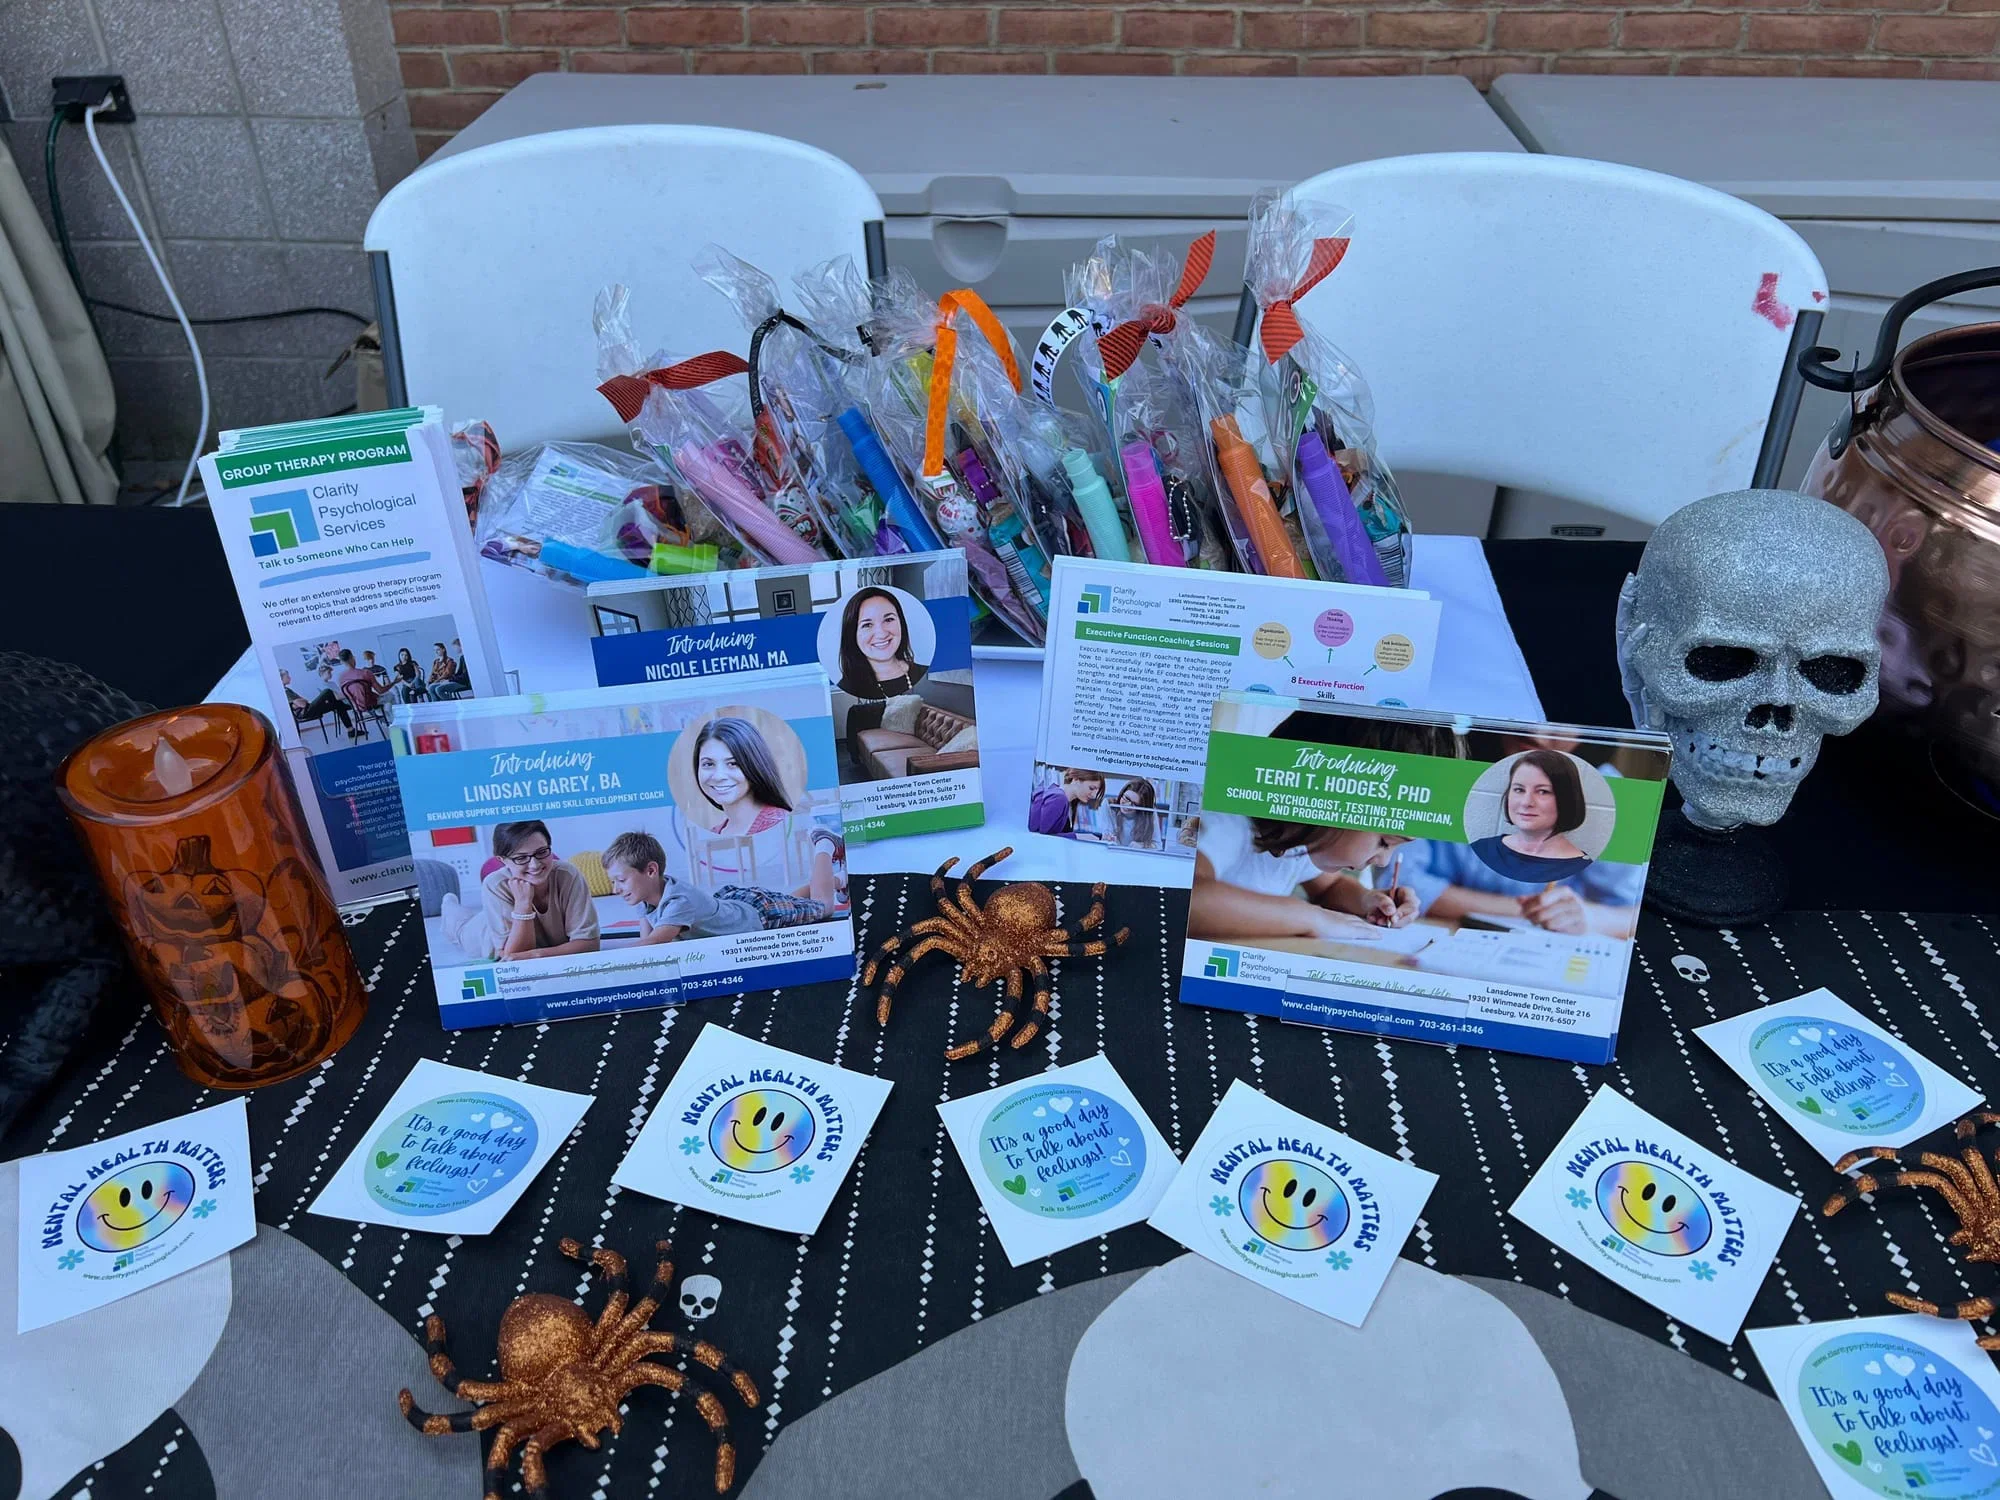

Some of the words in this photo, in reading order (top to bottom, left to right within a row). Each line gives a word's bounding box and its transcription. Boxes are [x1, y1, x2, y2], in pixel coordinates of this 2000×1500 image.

[223, 464, 271, 480] GROUP
[274, 454, 335, 472] THERAPY
[340, 444, 407, 462] PROGRAM
[312, 482, 358, 499] Clarity
[318, 493, 417, 519] Psychological
[323, 519, 386, 537] Services
[258, 559, 282, 570] Talk
[296, 549, 343, 563] Someone
[344, 544, 368, 554] Who
[370, 541, 389, 550] Can
[391, 537, 414, 547] Help
[262, 601, 278, 609] We
[279, 597, 298, 606] offer
[312, 587, 351, 600] extensive
[352, 583, 376, 594] group
[377, 578, 407, 588] therapy
[408, 573, 442, 584] program
[269, 607, 305, 619] covering
[305, 602, 332, 612] topics
[332, 597, 349, 606] that
[350, 592, 382, 604] address
[383, 586, 415, 598] specific
[415, 583, 441, 592] issues
[1112, 596, 1162, 608] Psychological
[1114, 586, 1136, 597] Clarity
[278, 615, 311, 628] relevant
[322, 606, 357, 619] different
[358, 603, 378, 613] ages
[380, 599, 395, 608] and
[395, 598, 408, 606] life
[409, 594, 438, 604] stages.
[1112, 606, 1142, 616] Services
[667, 632, 757, 657] Introducing
[1085, 627, 1122, 638] Executive
[1123, 631, 1158, 642] Function
[1158, 635, 1195, 647] Coaching
[1195, 639, 1230, 649] Sessions
[645, 660, 699, 680] NICOLE
[702, 653, 764, 677] LEFMAN,
[767, 650, 788, 666] MA
[1079, 645, 1108, 654] Executive
[1110, 648, 1137, 657] Function
[1139, 651, 1152, 659] (EF)
[1154, 654, 1181, 663] coaching
[1184, 656, 1208, 665] teaches
[1291, 676, 1297, 684] 8
[1298, 677, 1332, 688] Executive
[1333, 680, 1365, 691] Function
[1316, 690, 1335, 700] Skills
[490, 750, 595, 778] Introducing
[1292, 748, 1398, 782] Introducing
[464, 780, 531, 803] LINDSAY
[537, 775, 595, 796] GAREY,
[599, 772, 621, 790] BA
[1255, 767, 1300, 788] TERRI
[1307, 773, 1318, 790] T.
[1324, 776, 1391, 801] HODGES,
[1397, 784, 1431, 804] PHD
[426, 810, 464, 821] BEHAVIOR
[465, 806, 499, 818] SUPPORT
[501, 802, 543, 814] SPECIALIST
[546, 801, 561, 810] AND
[562, 799, 584, 809] SKILL
[584, 793, 637, 806] DEVELOPMENT
[639, 790, 664, 801] COACH
[1226, 787, 1264, 802] SCHOOL
[1266, 792, 1342, 812] PSYCHOLOGIST,
[1346, 802, 1388, 817] TESTING
[1391, 807, 1452, 826] TECHNICIAN,
[1269, 804, 1290, 816] AND
[1292, 806, 1339, 822] PROGRAM
[1341, 813, 1405, 831] FACILITATOR
[721, 947, 742, 956] 19301
[744, 942, 780, 953] Winmeade
[802, 938, 820, 946] Suite
[736, 935, 775, 945] Lansdowne
[796, 929, 819, 937] Center
[735, 954, 769, 963] Leesburg,
[782, 946, 823, 957] 20176-6507
[1241, 962, 1291, 974] Psychological
[1242, 952, 1266, 962] Clarity
[546, 987, 678, 1008] www.claritypsychological.com
[681, 975, 744, 990] 703-261-4346
[1240, 970, 1272, 982] Services
[1468, 995, 1490, 1004] 19301
[1492, 997, 1531, 1009] Winmeade
[1532, 1003, 1553, 1014] Drive,
[1555, 1006, 1575, 1016] Suite
[1576, 1010, 1591, 1018] 216
[1486, 986, 1528, 999] Lansdowne
[1530, 992, 1550, 1002] Town
[1551, 996, 1577, 1006] Center
[1281, 998, 1415, 1026] www.claritypsychological.com
[1419, 1019, 1484, 1035] 703-261-4346
[1480, 1006, 1516, 1018] Leesburg,
[1518, 1011, 1529, 1019] VA
[1530, 1013, 1576, 1026] 20176-6507
[1761, 1063, 1791, 1078] It's
[1790, 1059, 1803, 1068] a
[1803, 1044, 1834, 1067] good
[1834, 1033, 1863, 1052] day
[1786, 1077, 1805, 1092] to
[1802, 1065, 1835, 1086] talk
[1834, 1048, 1876, 1074] about
[1820, 1068, 1881, 1104] feelings!
[681, 1074, 744, 1126] MENTAL
[750, 1069, 820, 1096] HEALTH
[816, 1094, 843, 1162] MATTERS
[988, 1136, 1018, 1153] It's
[1022, 1132, 1035, 1142] a
[1039, 1114, 1076, 1140] good
[1078, 1103, 1109, 1121] day
[405, 1114, 435, 1132] It's
[437, 1124, 450, 1135] a
[452, 1128, 492, 1144] good
[494, 1132, 527, 1151] day
[1005, 1154, 1025, 1170] to
[1025, 1140, 1063, 1163] talk
[1066, 1121, 1114, 1148] about
[401, 1134, 418, 1149] to
[421, 1136, 458, 1155] talk
[459, 1147, 512, 1165] about
[1037, 1143, 1107, 1182] feelings!
[405, 1155, 481, 1179] feelings!
[42, 1182, 87, 1249] MENTAL
[86, 1140, 169, 1180] HEALTH
[173, 1140, 226, 1190] MATTERS
[1210, 1138, 1272, 1185] MENTAL
[1278, 1137, 1352, 1177] HEALTH
[1348, 1177, 1380, 1252] MATTERS
[1566, 1137, 1630, 1178] MENTAL
[1635, 1139, 1713, 1188] HEALTH
[1710, 1192, 1744, 1266] MATTERS
[1808, 1386, 1848, 1407] It's
[1853, 1390, 1869, 1404] a
[1872, 1378, 1921, 1407] good
[1923, 1376, 1962, 1398] day
[1832, 1412, 1857, 1433] to
[1858, 1406, 1906, 1430] talk
[1910, 1400, 1970, 1426] about
[1874, 1425, 1963, 1458] feelings!
